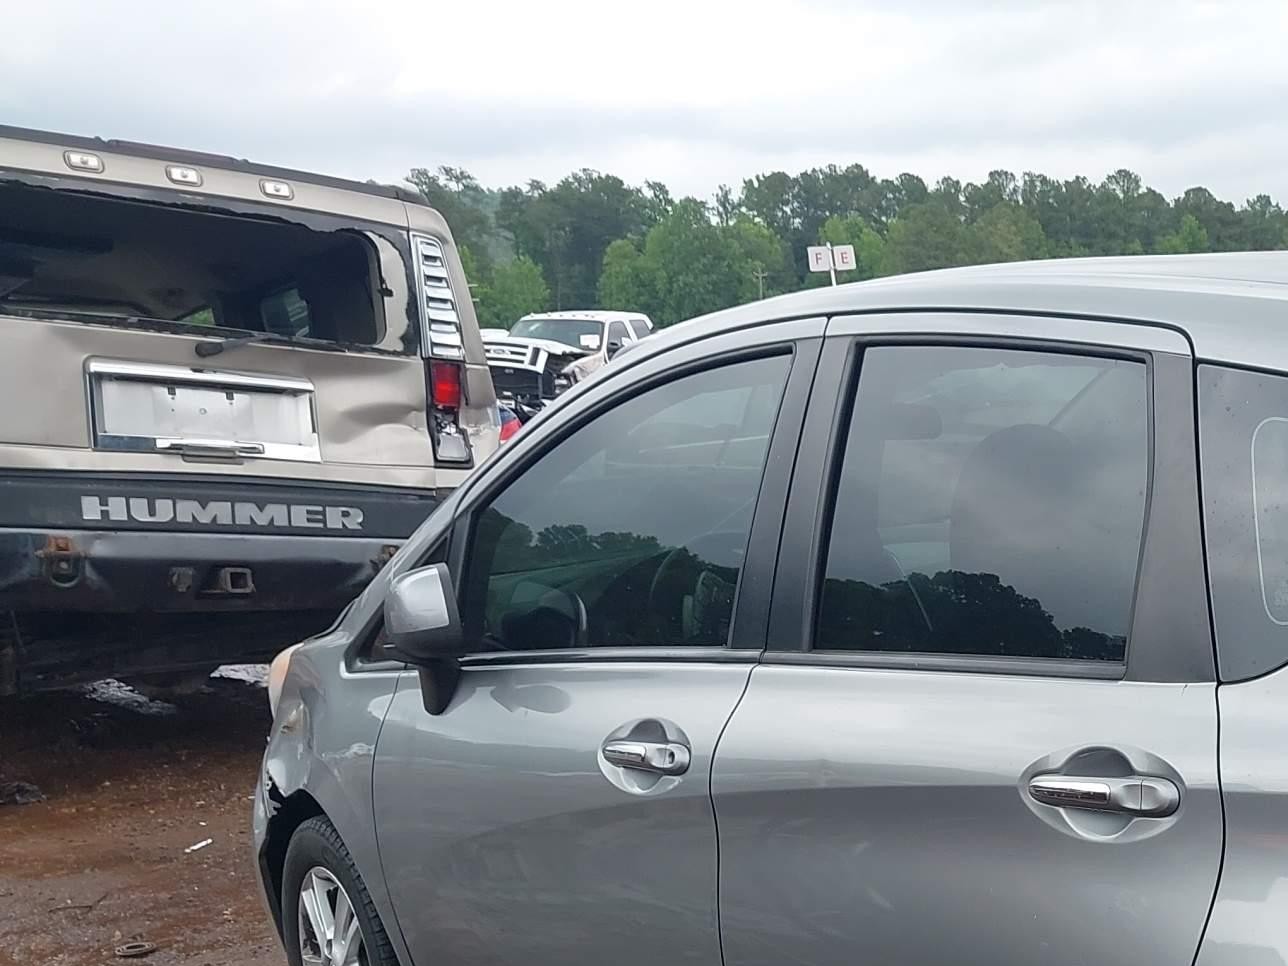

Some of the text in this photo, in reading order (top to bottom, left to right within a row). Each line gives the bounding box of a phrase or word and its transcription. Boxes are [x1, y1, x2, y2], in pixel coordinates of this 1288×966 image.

[815, 251, 849, 265] F E
[80, 495, 364, 530] HUMMER
